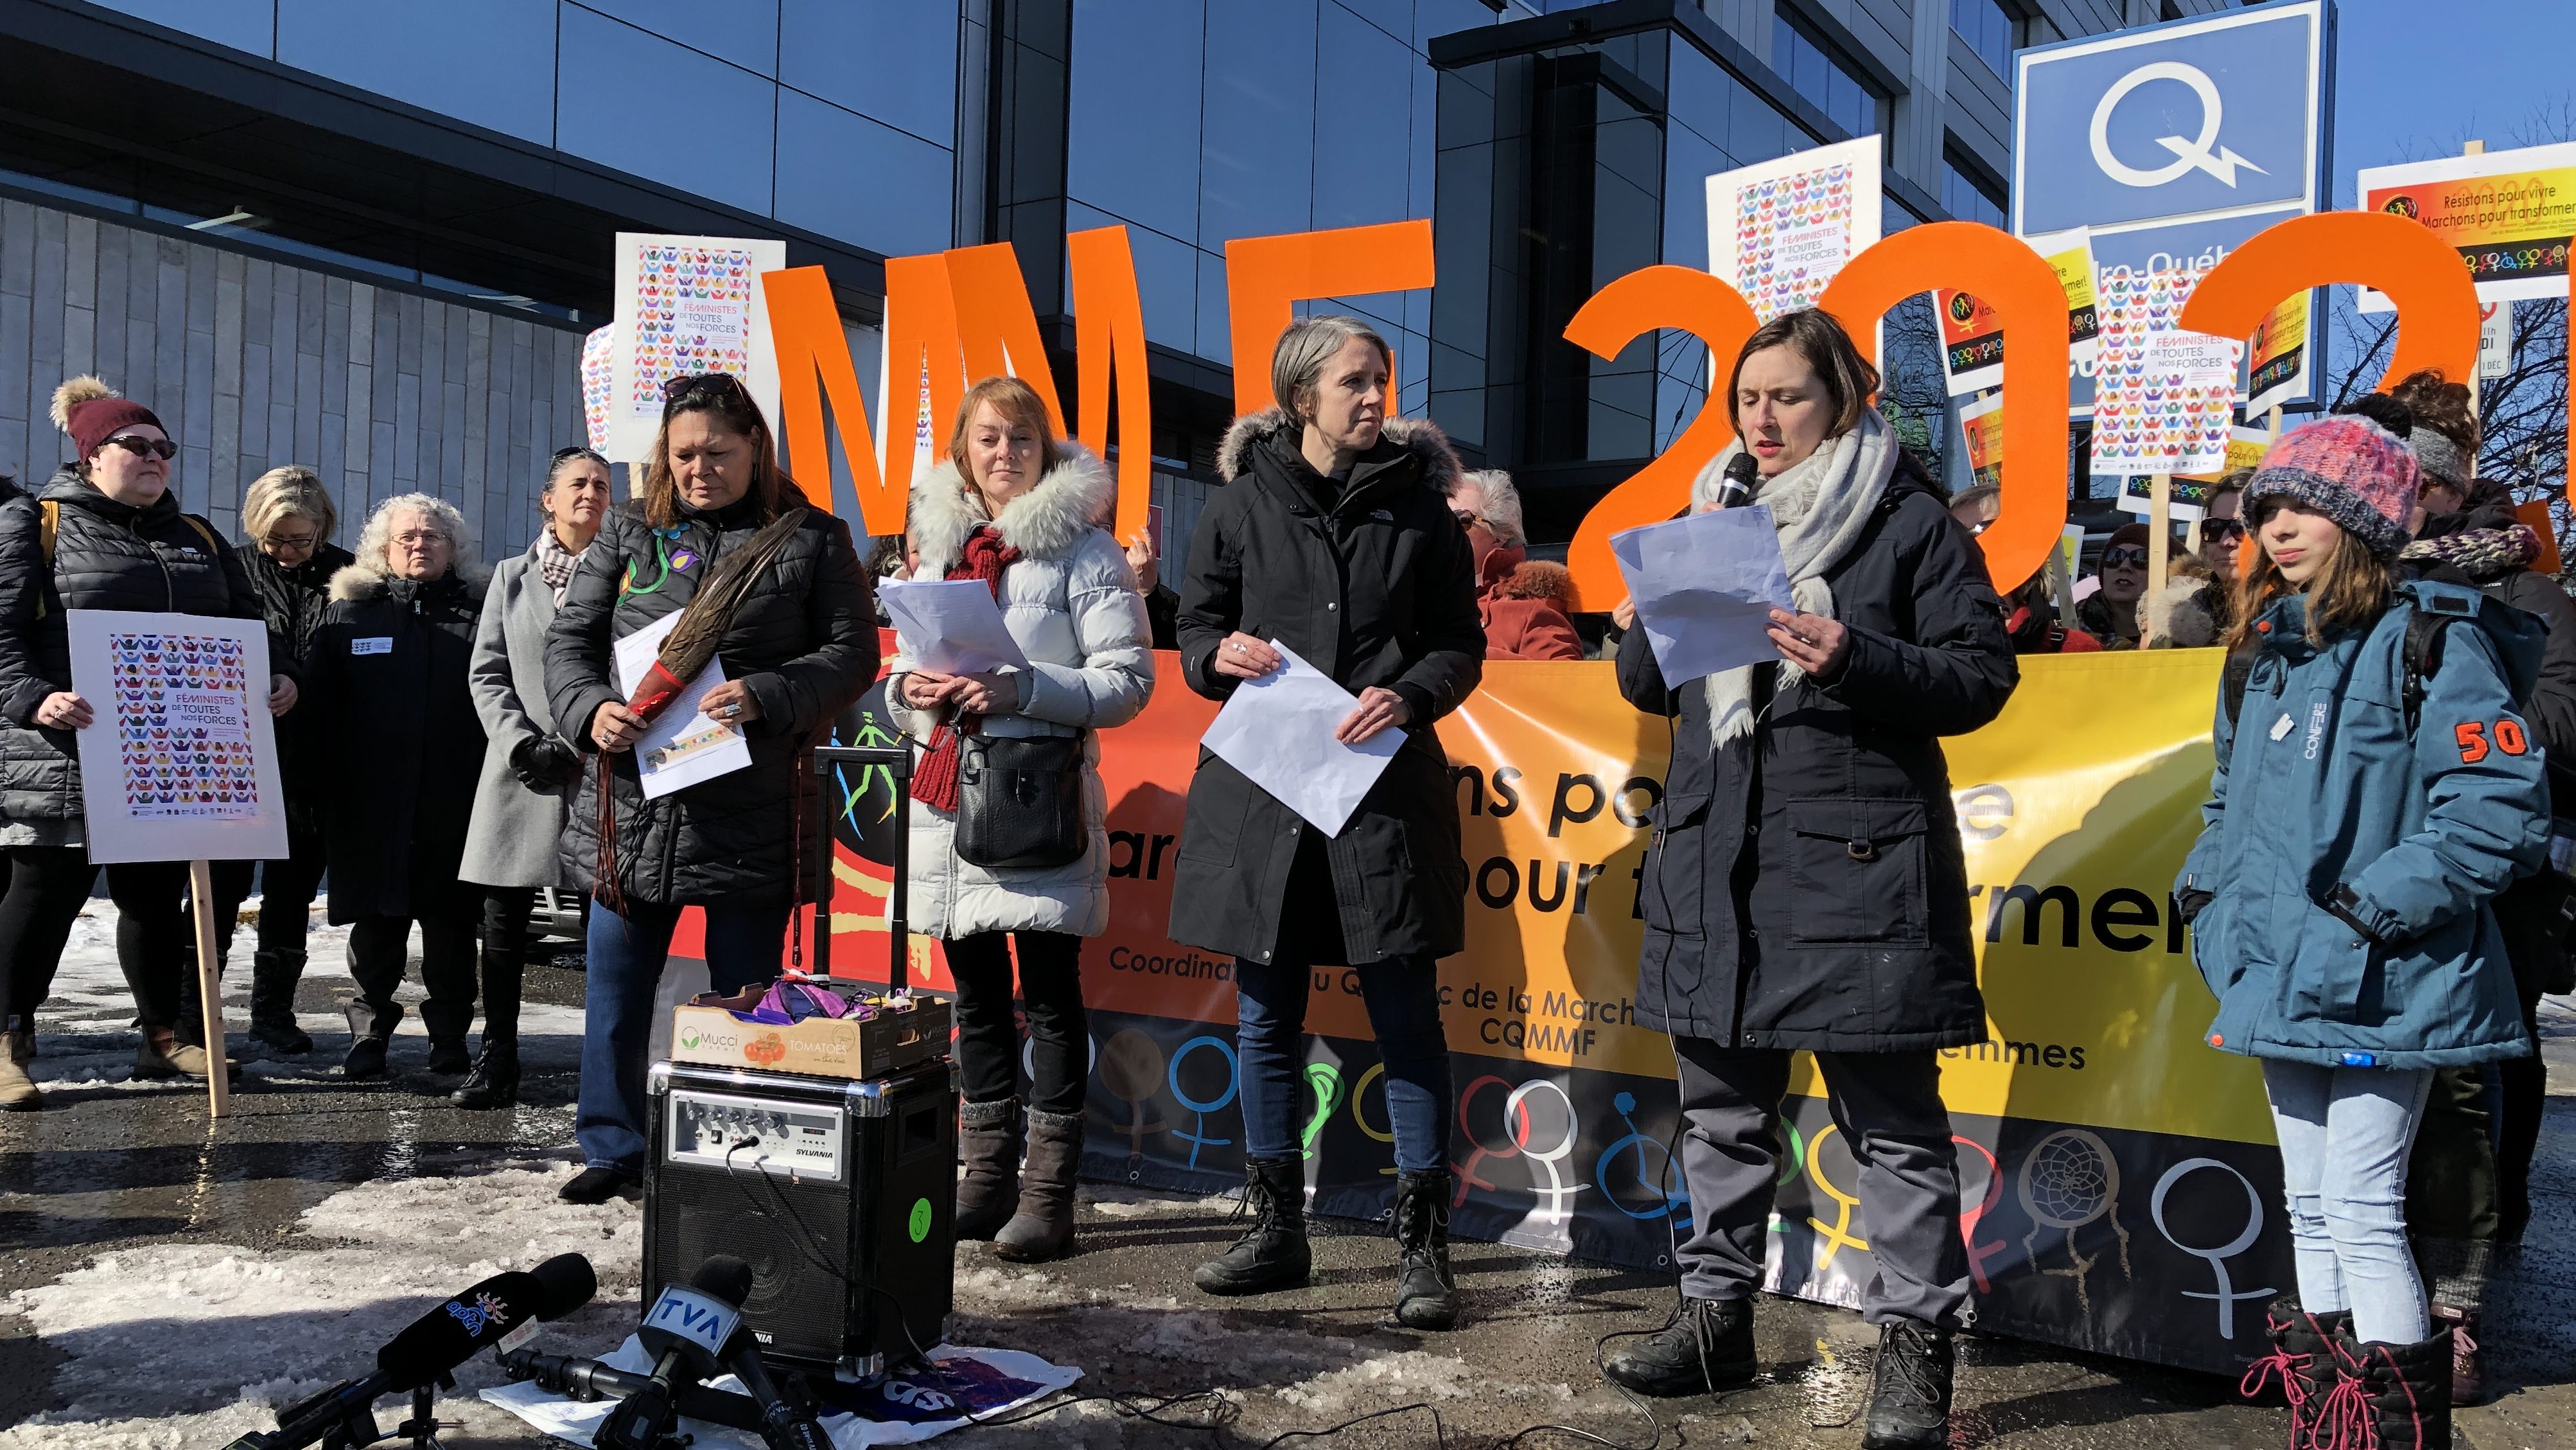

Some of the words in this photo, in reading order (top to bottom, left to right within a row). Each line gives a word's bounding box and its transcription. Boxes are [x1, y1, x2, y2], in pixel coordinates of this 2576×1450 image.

[2444, 193, 2493, 209] Résistons
[2498, 190, 2525, 204] pour
[2528, 186, 2555, 199] vivre
[2422, 215, 2475, 229] Marchons
[2480, 209, 2507, 223] pour
[1783, 227, 1838, 245] FÉMINISTES
[1789, 240, 1823, 254] TOUTES
[1800, 248, 1838, 263] FORCES
[684, 302, 737, 314] FÉMINISTES
[689, 314, 722, 323] TOUTES
[700, 323, 736, 333] FORCES
[2156, 335, 2223, 348] FÉMINISTES
[2162, 347, 2204, 358] TOUTES
[2176, 357, 2223, 369] FORCES
[2487, 360, 2502, 370] DÉC
[2228, 451, 2246, 461] pour
[176, 693, 234, 705] FÉMINISTES
[182, 705, 220, 714] TOUTES
[198, 715, 236, 725] FORCES
[2455, 720, 2528, 765] 50
[1462, 856, 1607, 914] our
[1109, 946, 1237, 982] Coordina
[1462, 983, 1498, 1009] de
[1507, 986, 1532, 1014] la
[1542, 991, 1636, 1027] March
[1939, 1038, 2086, 1070] emmes
[701, 1032, 738, 1047] Mucci
[1480, 1017, 1596, 1056] CQMMF
[790, 1039, 847, 1055] TOMATOES
[796, 1149, 833, 1158] SYLVANIA
[915, 1210, 924, 1235] 3
[446, 1301, 482, 1337] aptn
[661, 1298, 720, 1340] TVA
